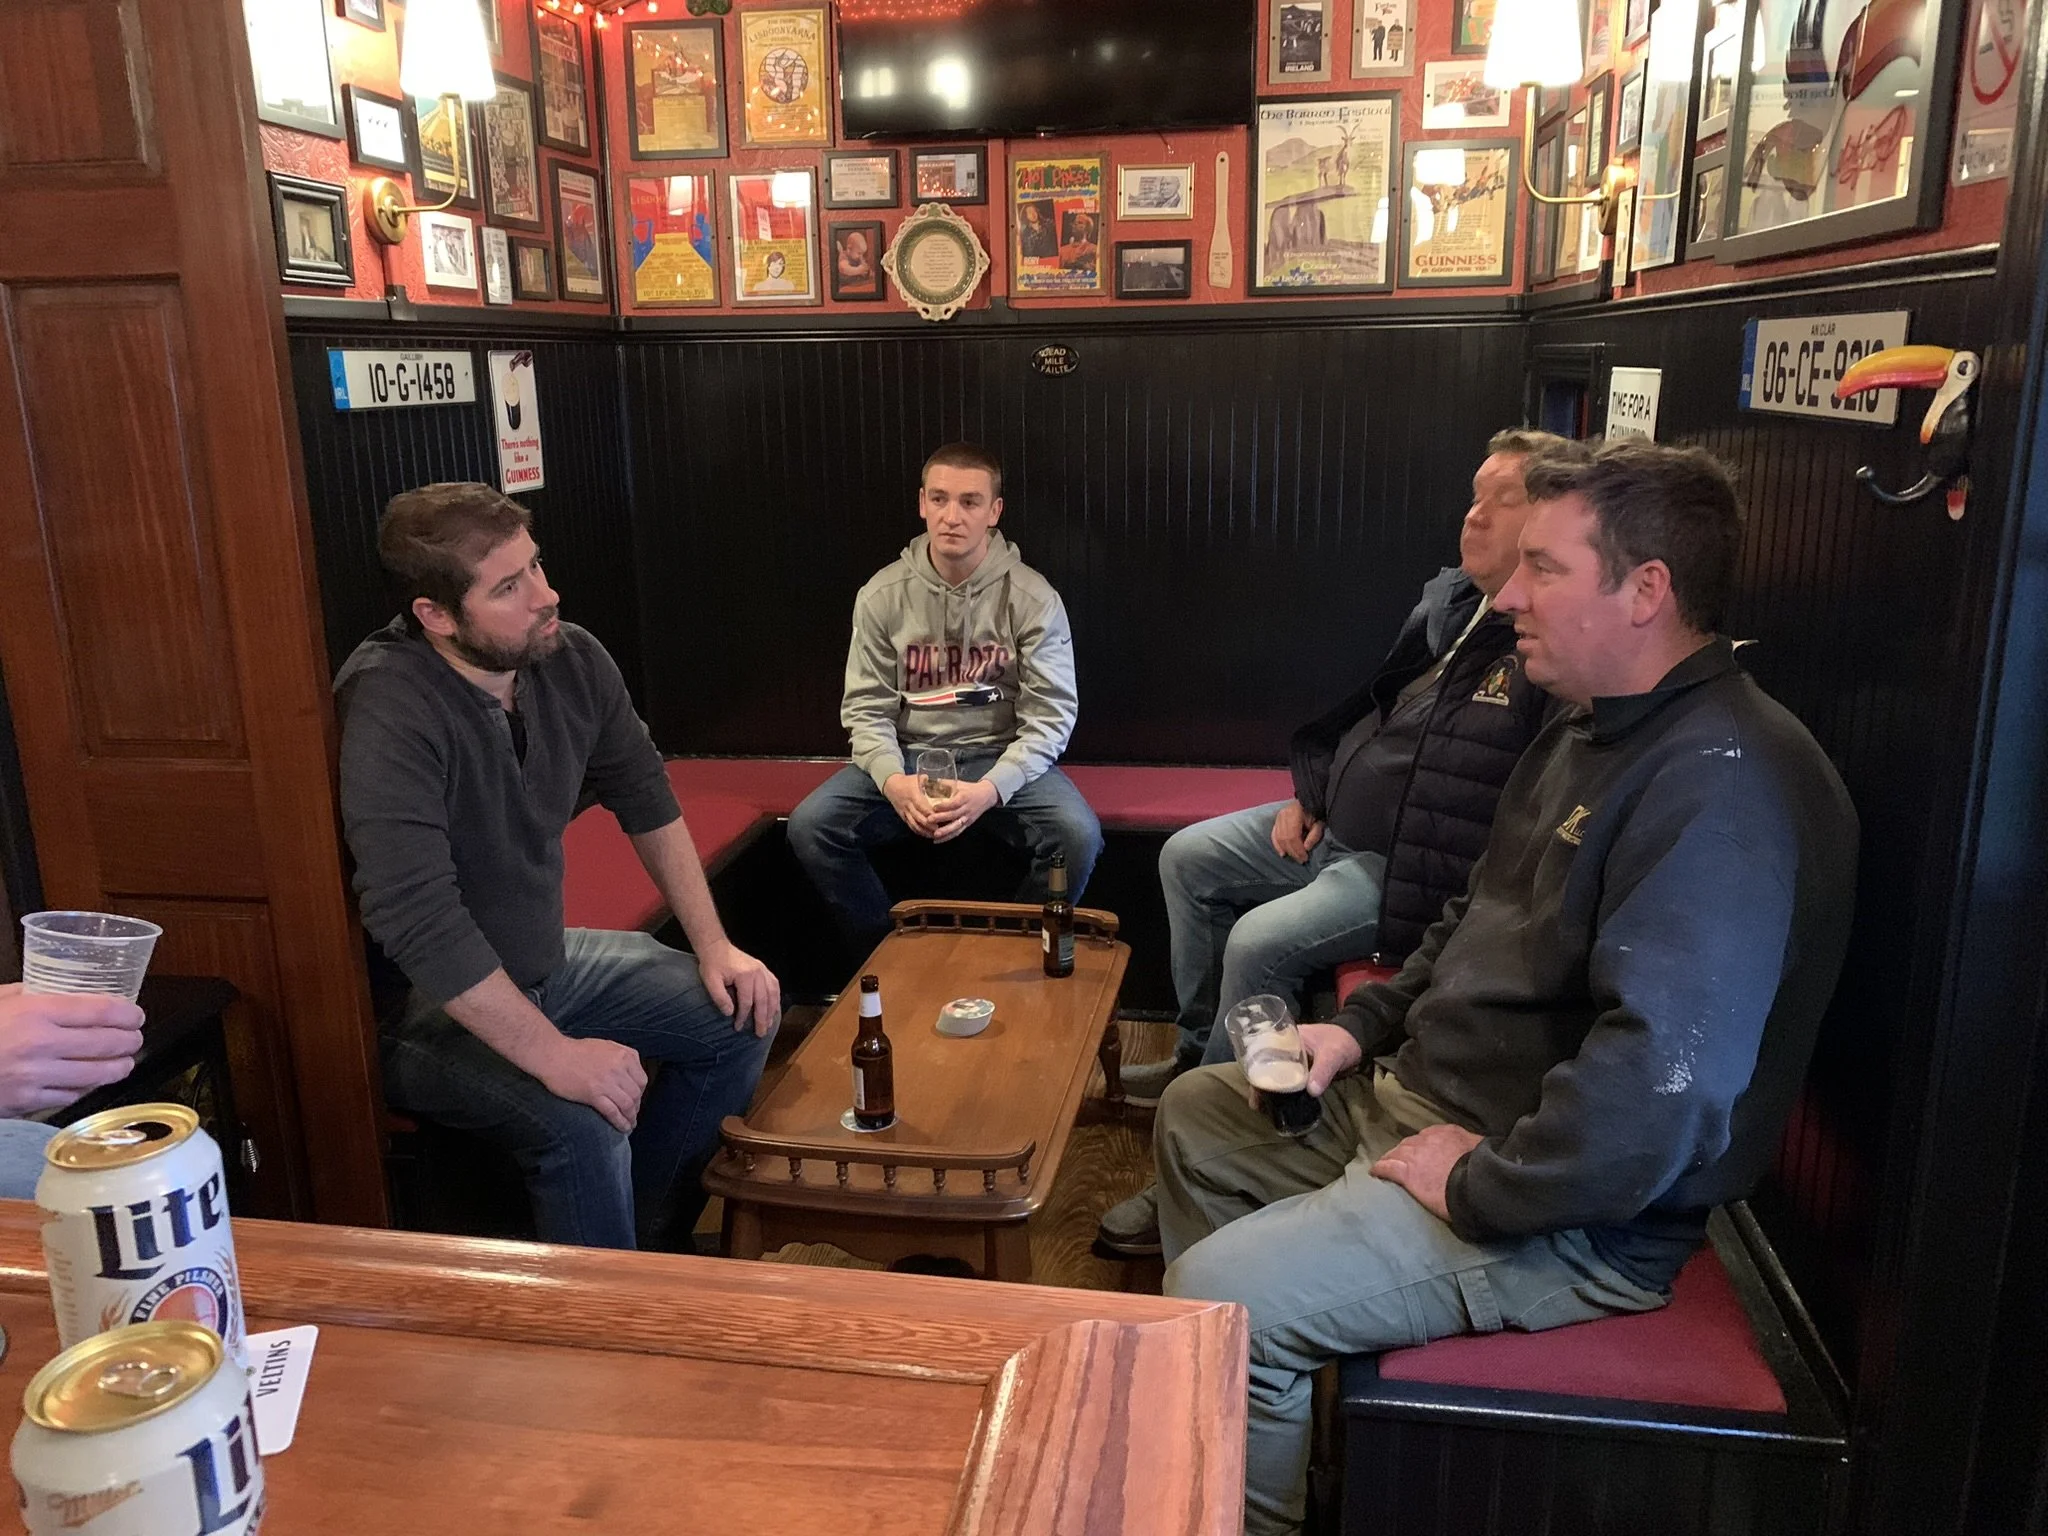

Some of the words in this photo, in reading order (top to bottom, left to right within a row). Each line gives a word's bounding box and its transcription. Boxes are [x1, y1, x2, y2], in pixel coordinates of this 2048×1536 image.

[1285, 64, 1315, 72] IRELAND
[1415, 254, 1497, 267] GUINNESS
[1811, 325, 1820, 335] AN
[368, 362, 456, 403] 10-G-1458
[335, 387, 347, 400] IRL
[1611, 391, 1628, 417] TIME
[1628, 393, 1645, 420] FOR
[1644, 396, 1651, 421] A
[501, 438, 518, 450] There's
[519, 437, 539, 450] nothing
[514, 452, 524, 462] like
[505, 466, 540, 484] GUINNESS
[87, 1172, 222, 1280] Lite
[133, 1282, 171, 1319] FINE
[173, 1270, 224, 1299] PILSNER
[256, 1338, 292, 1398] VELTINS
